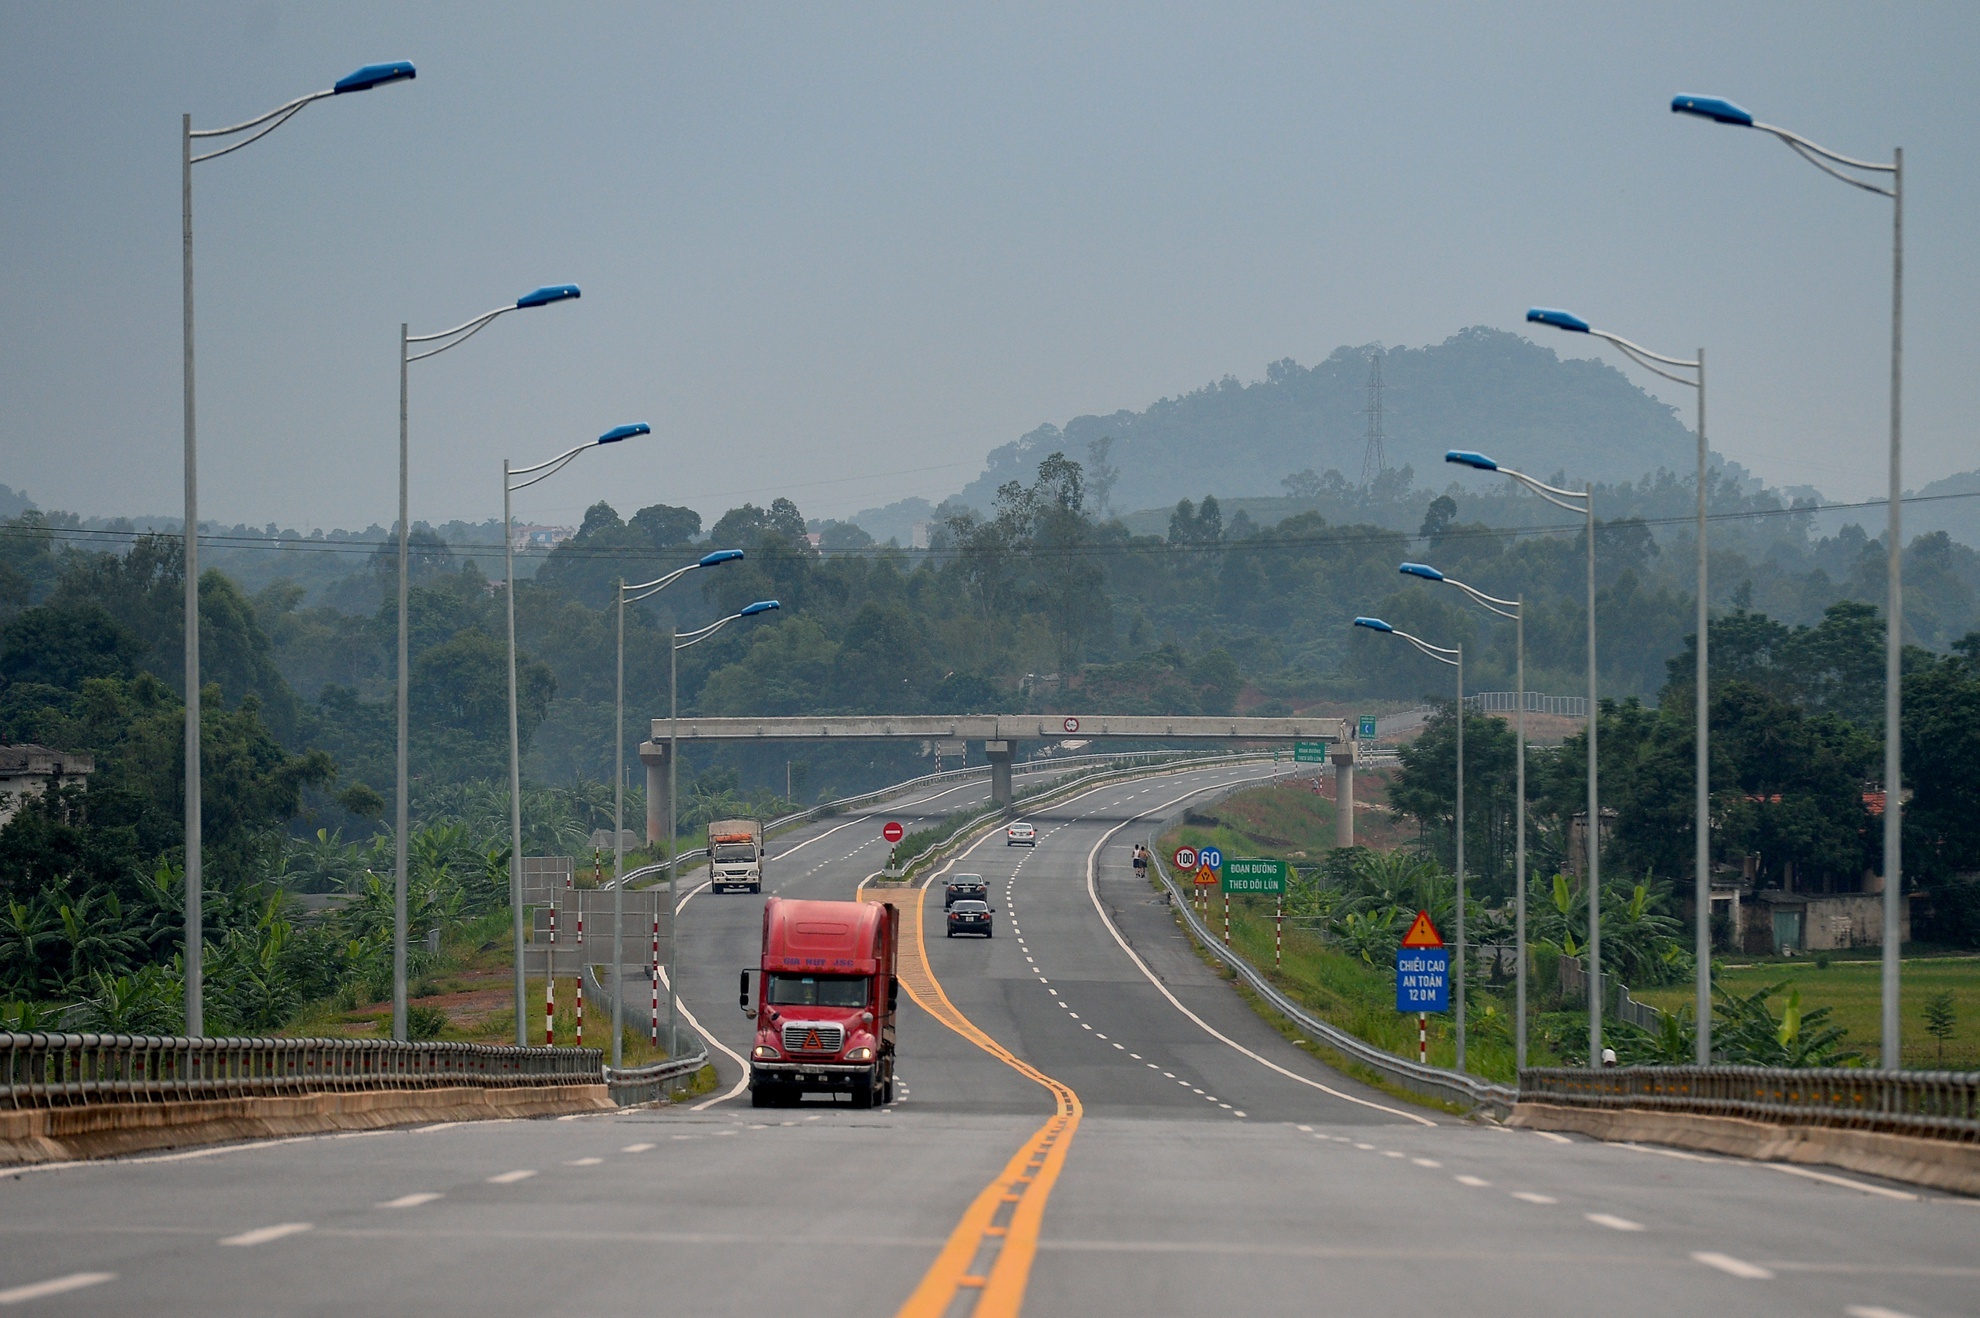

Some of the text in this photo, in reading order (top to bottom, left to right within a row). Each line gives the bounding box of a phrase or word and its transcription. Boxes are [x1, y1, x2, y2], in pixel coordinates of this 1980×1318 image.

[1178, 852, 1193, 864] 100
[1201, 851, 1219, 867] 60
[1230, 862, 1277, 875] ĐOẠN ĐƯỜNG
[1228, 877, 1279, 890] THEO DÕI LÚN
[783, 957, 800, 965] GIA
[1427, 960, 1445, 972] CAO
[1403, 972, 1442, 987] AN TOÀN
